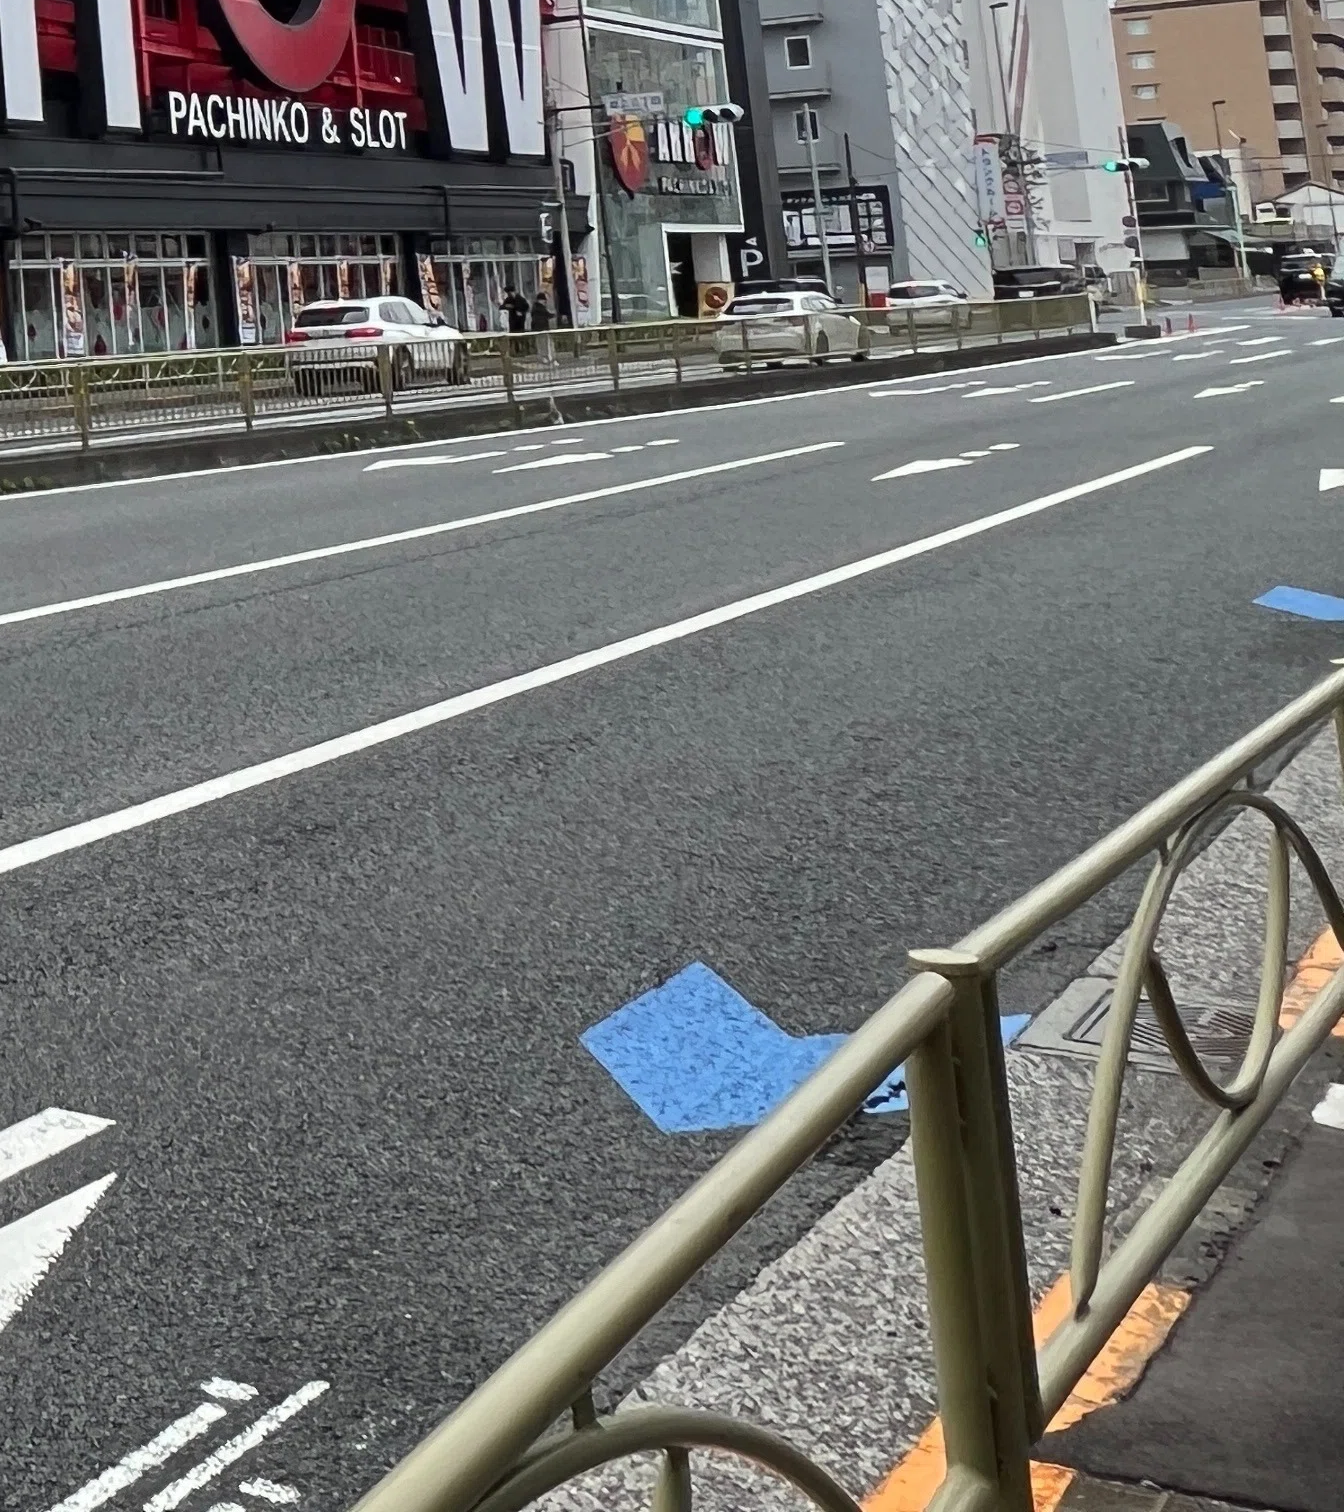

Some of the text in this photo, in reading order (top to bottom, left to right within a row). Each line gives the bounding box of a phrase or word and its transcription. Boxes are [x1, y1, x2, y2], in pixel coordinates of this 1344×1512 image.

[168, 91, 408, 150] PACHINKO & SLOT
